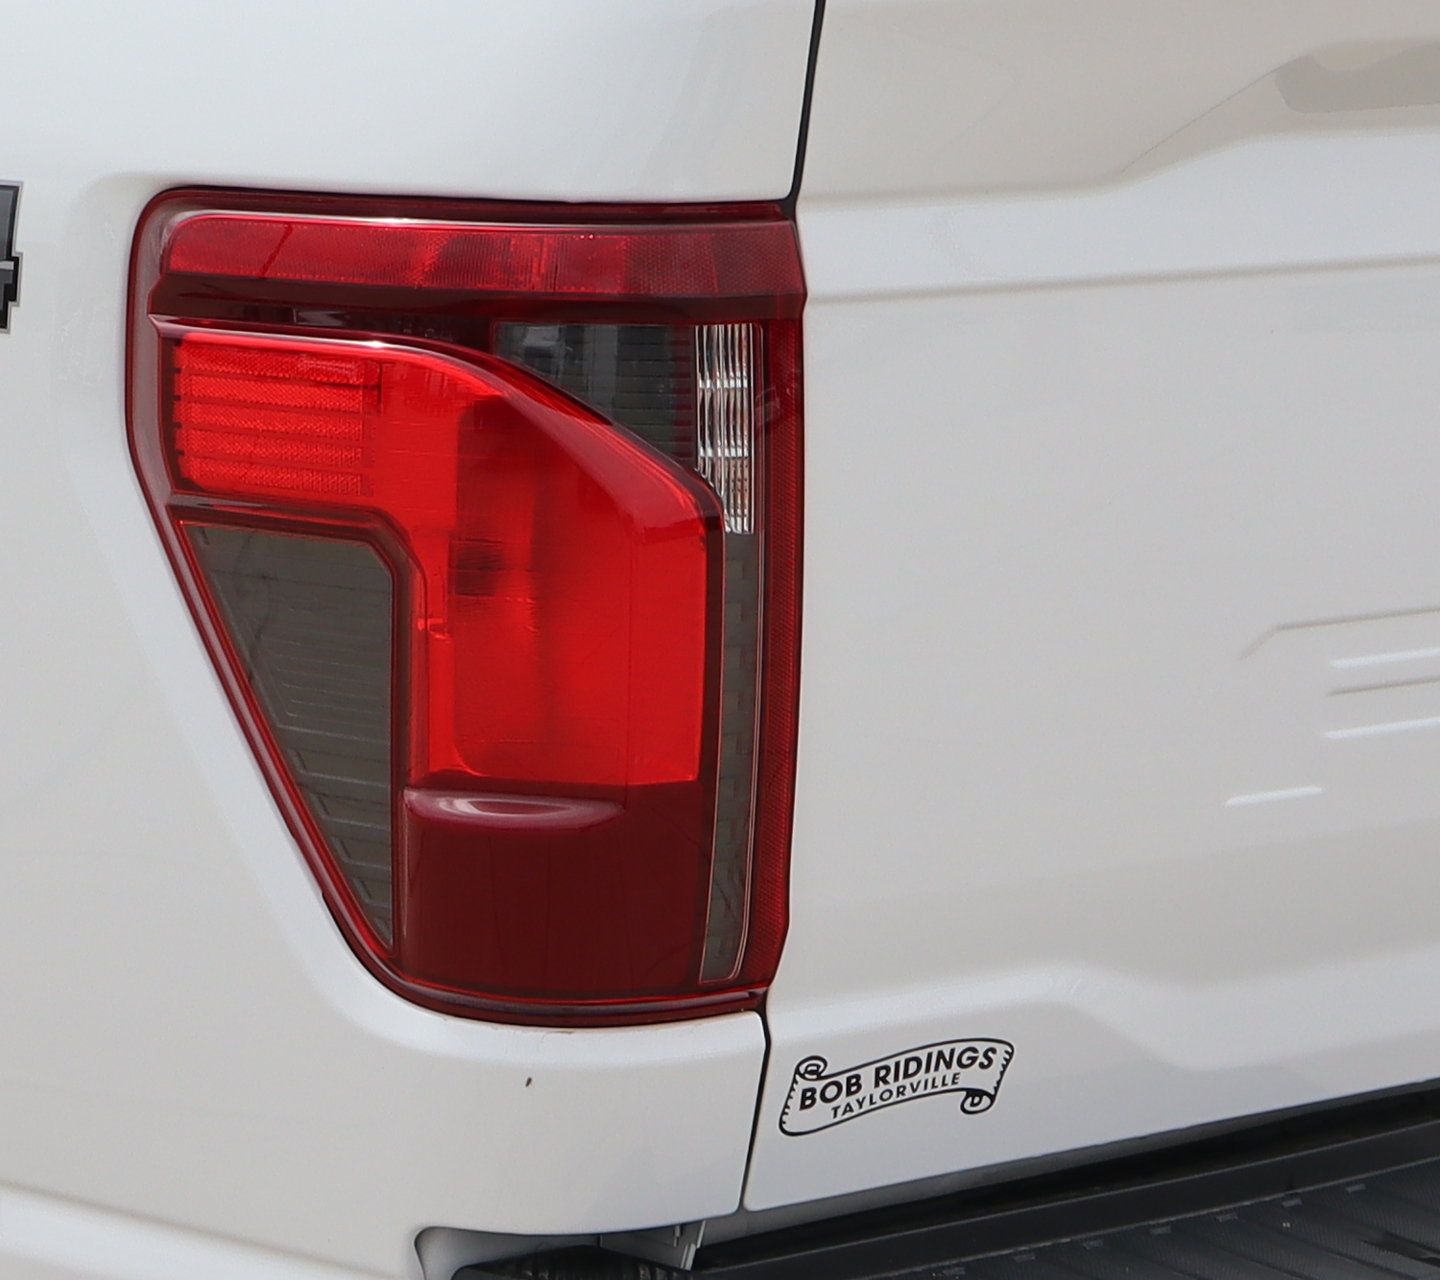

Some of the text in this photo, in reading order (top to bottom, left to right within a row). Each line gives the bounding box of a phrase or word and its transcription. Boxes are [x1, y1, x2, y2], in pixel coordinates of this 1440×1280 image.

[799, 1046, 997, 1111] BOB RIDINGS
[831, 1072, 961, 1119] TAYLORVILLE
